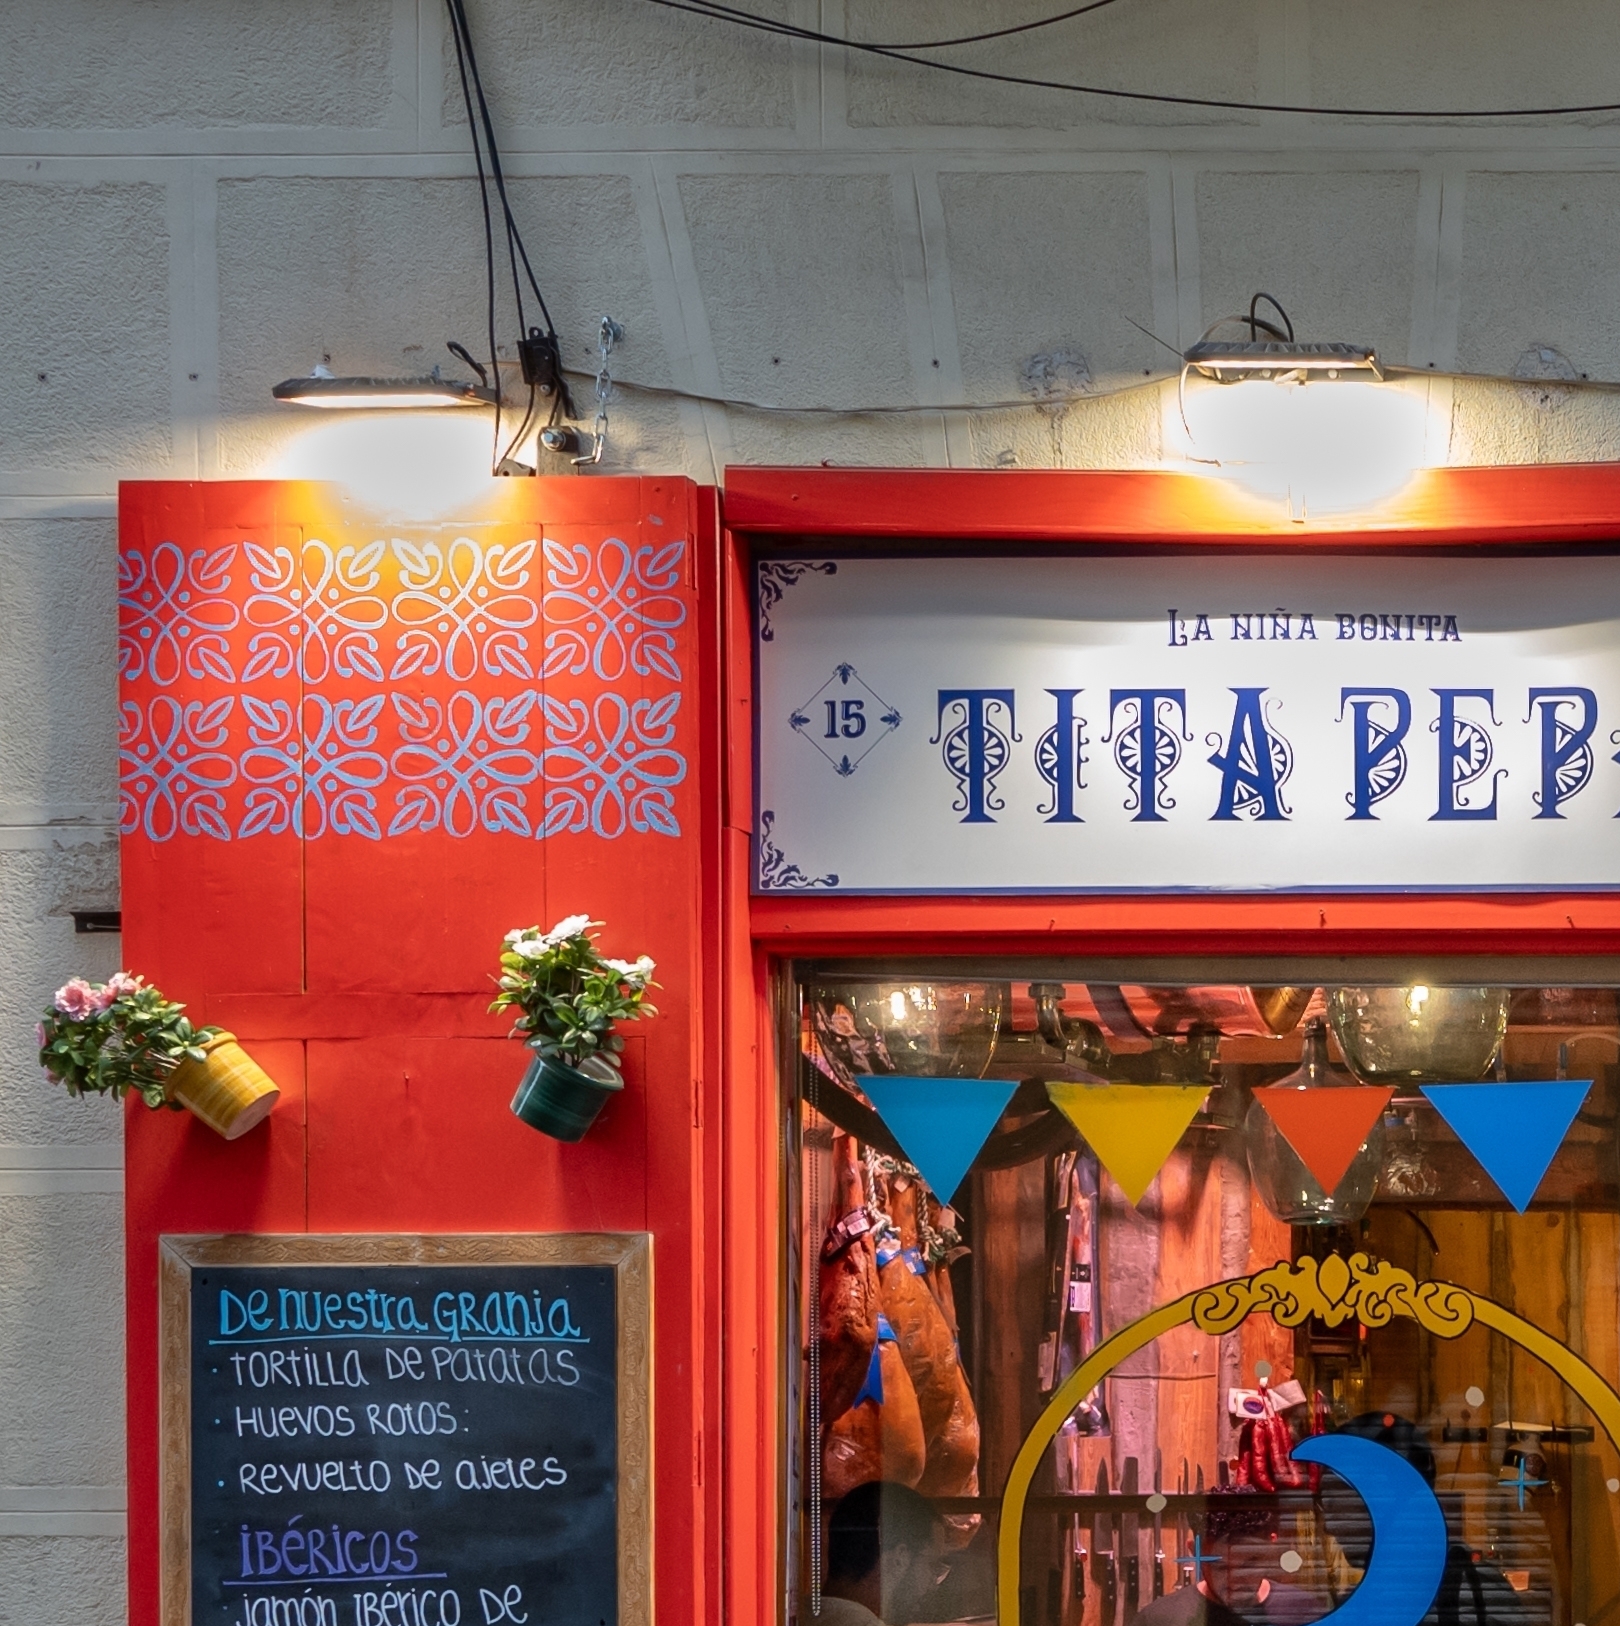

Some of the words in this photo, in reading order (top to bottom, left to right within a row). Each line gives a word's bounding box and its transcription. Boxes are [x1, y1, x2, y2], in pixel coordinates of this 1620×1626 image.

[1166, 608, 1215, 647] LA
[1230, 608, 1318, 643] NIÑA
[1337, 612, 1464, 645] BONITA
[824, 699, 867, 741] 15
[936, 685, 1294, 825] TITA
